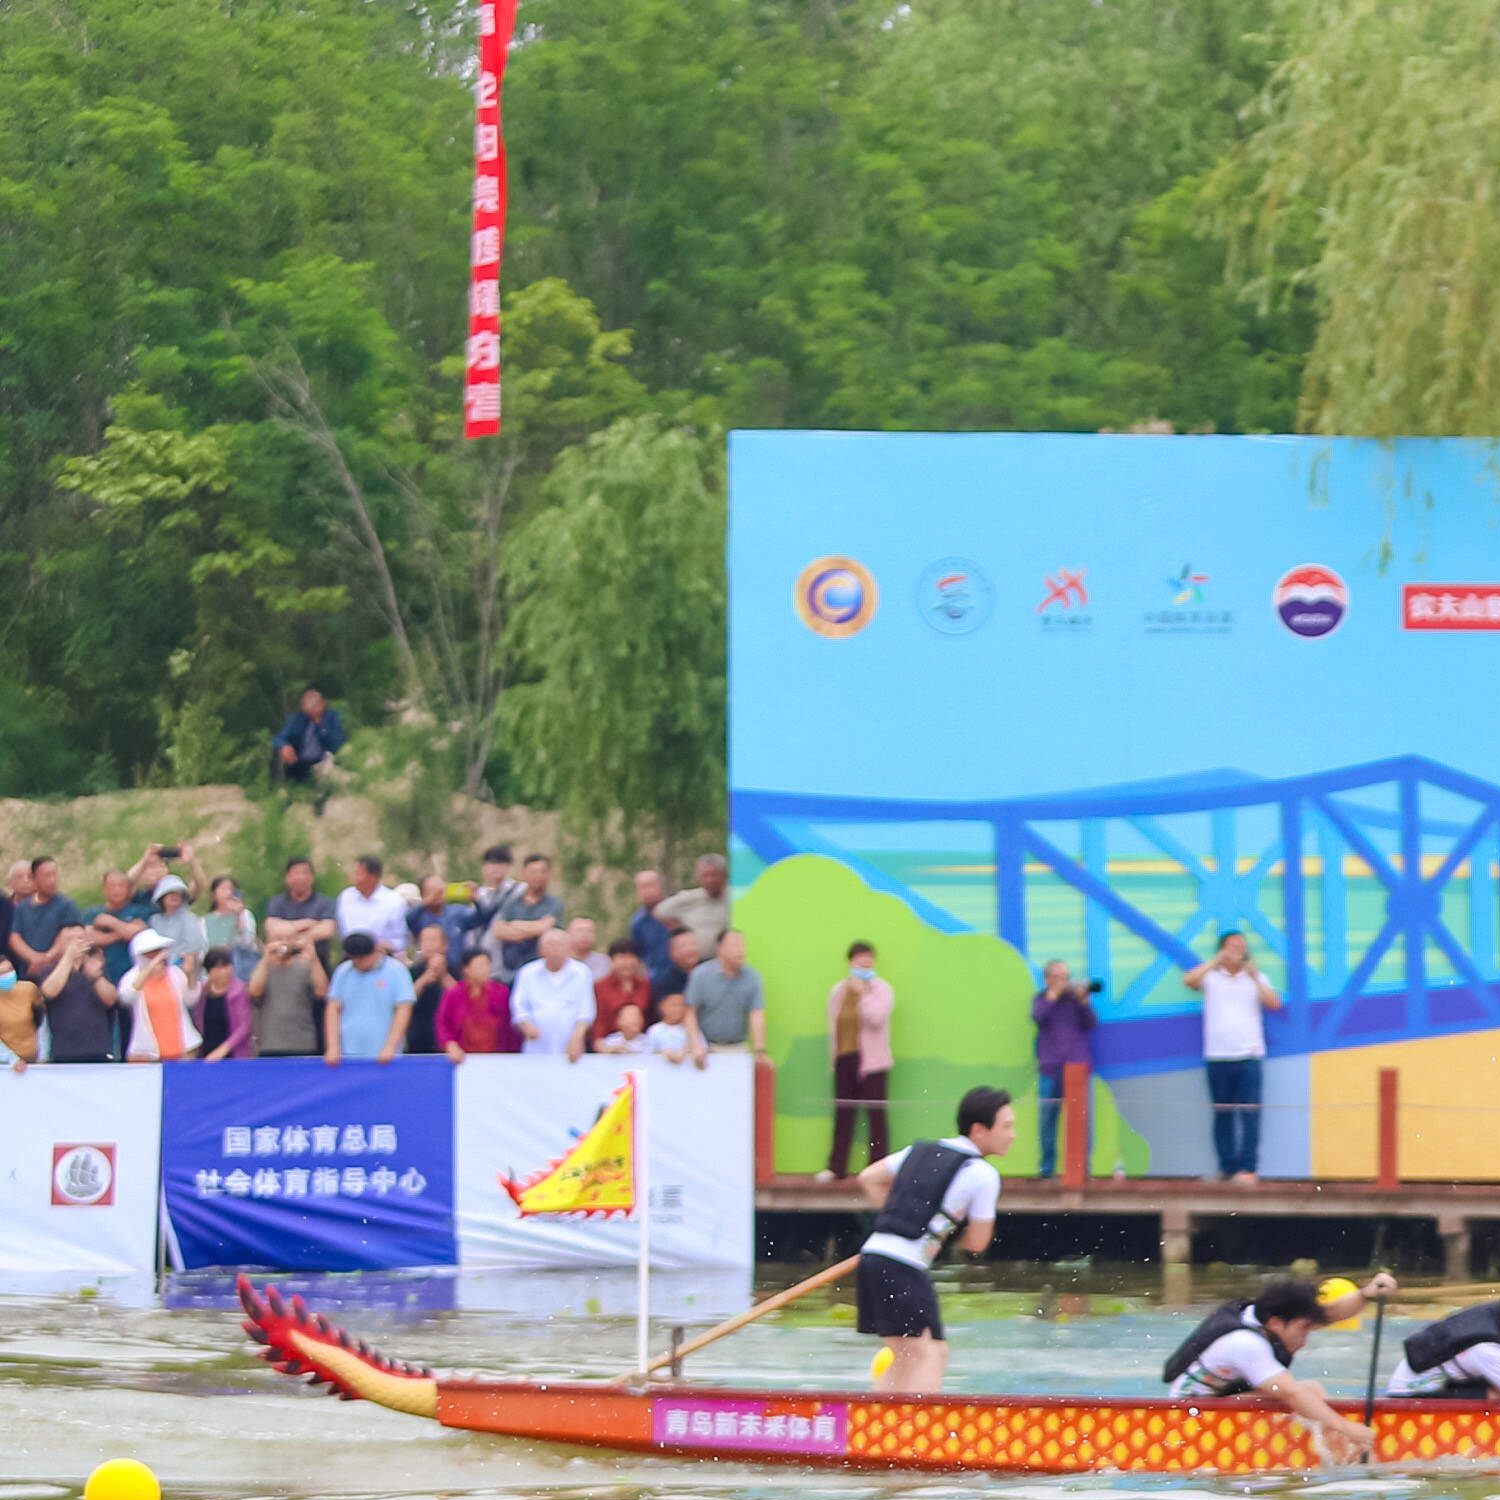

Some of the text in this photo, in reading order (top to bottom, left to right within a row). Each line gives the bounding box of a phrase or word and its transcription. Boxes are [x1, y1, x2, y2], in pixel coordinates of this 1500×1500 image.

[222, 1124, 398, 1158] 国家体育总局
[196, 1166, 427, 1199] 社会体育指导中心
[665, 1408, 837, 1443] 青岛新未来体育
